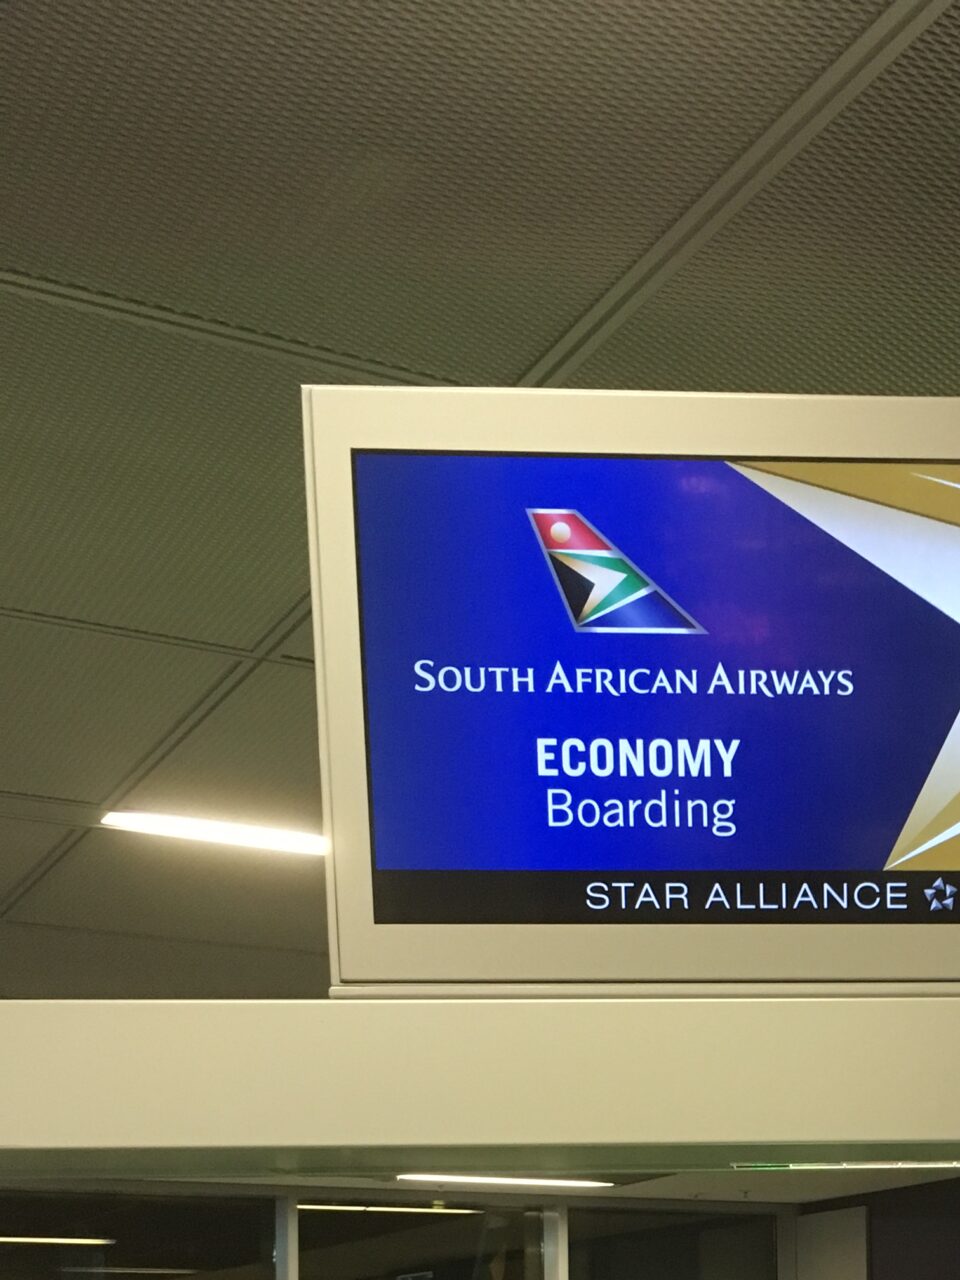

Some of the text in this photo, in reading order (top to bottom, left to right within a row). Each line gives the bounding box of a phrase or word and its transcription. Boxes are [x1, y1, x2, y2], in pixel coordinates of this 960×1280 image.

[413, 659, 855, 698] SOUTH AFRICAN AIRWAYS
[536, 737, 741, 778] ECONOMY
[546, 787, 737, 837] Boarding
[585, 882, 909, 910] STAR ALLIANCE
